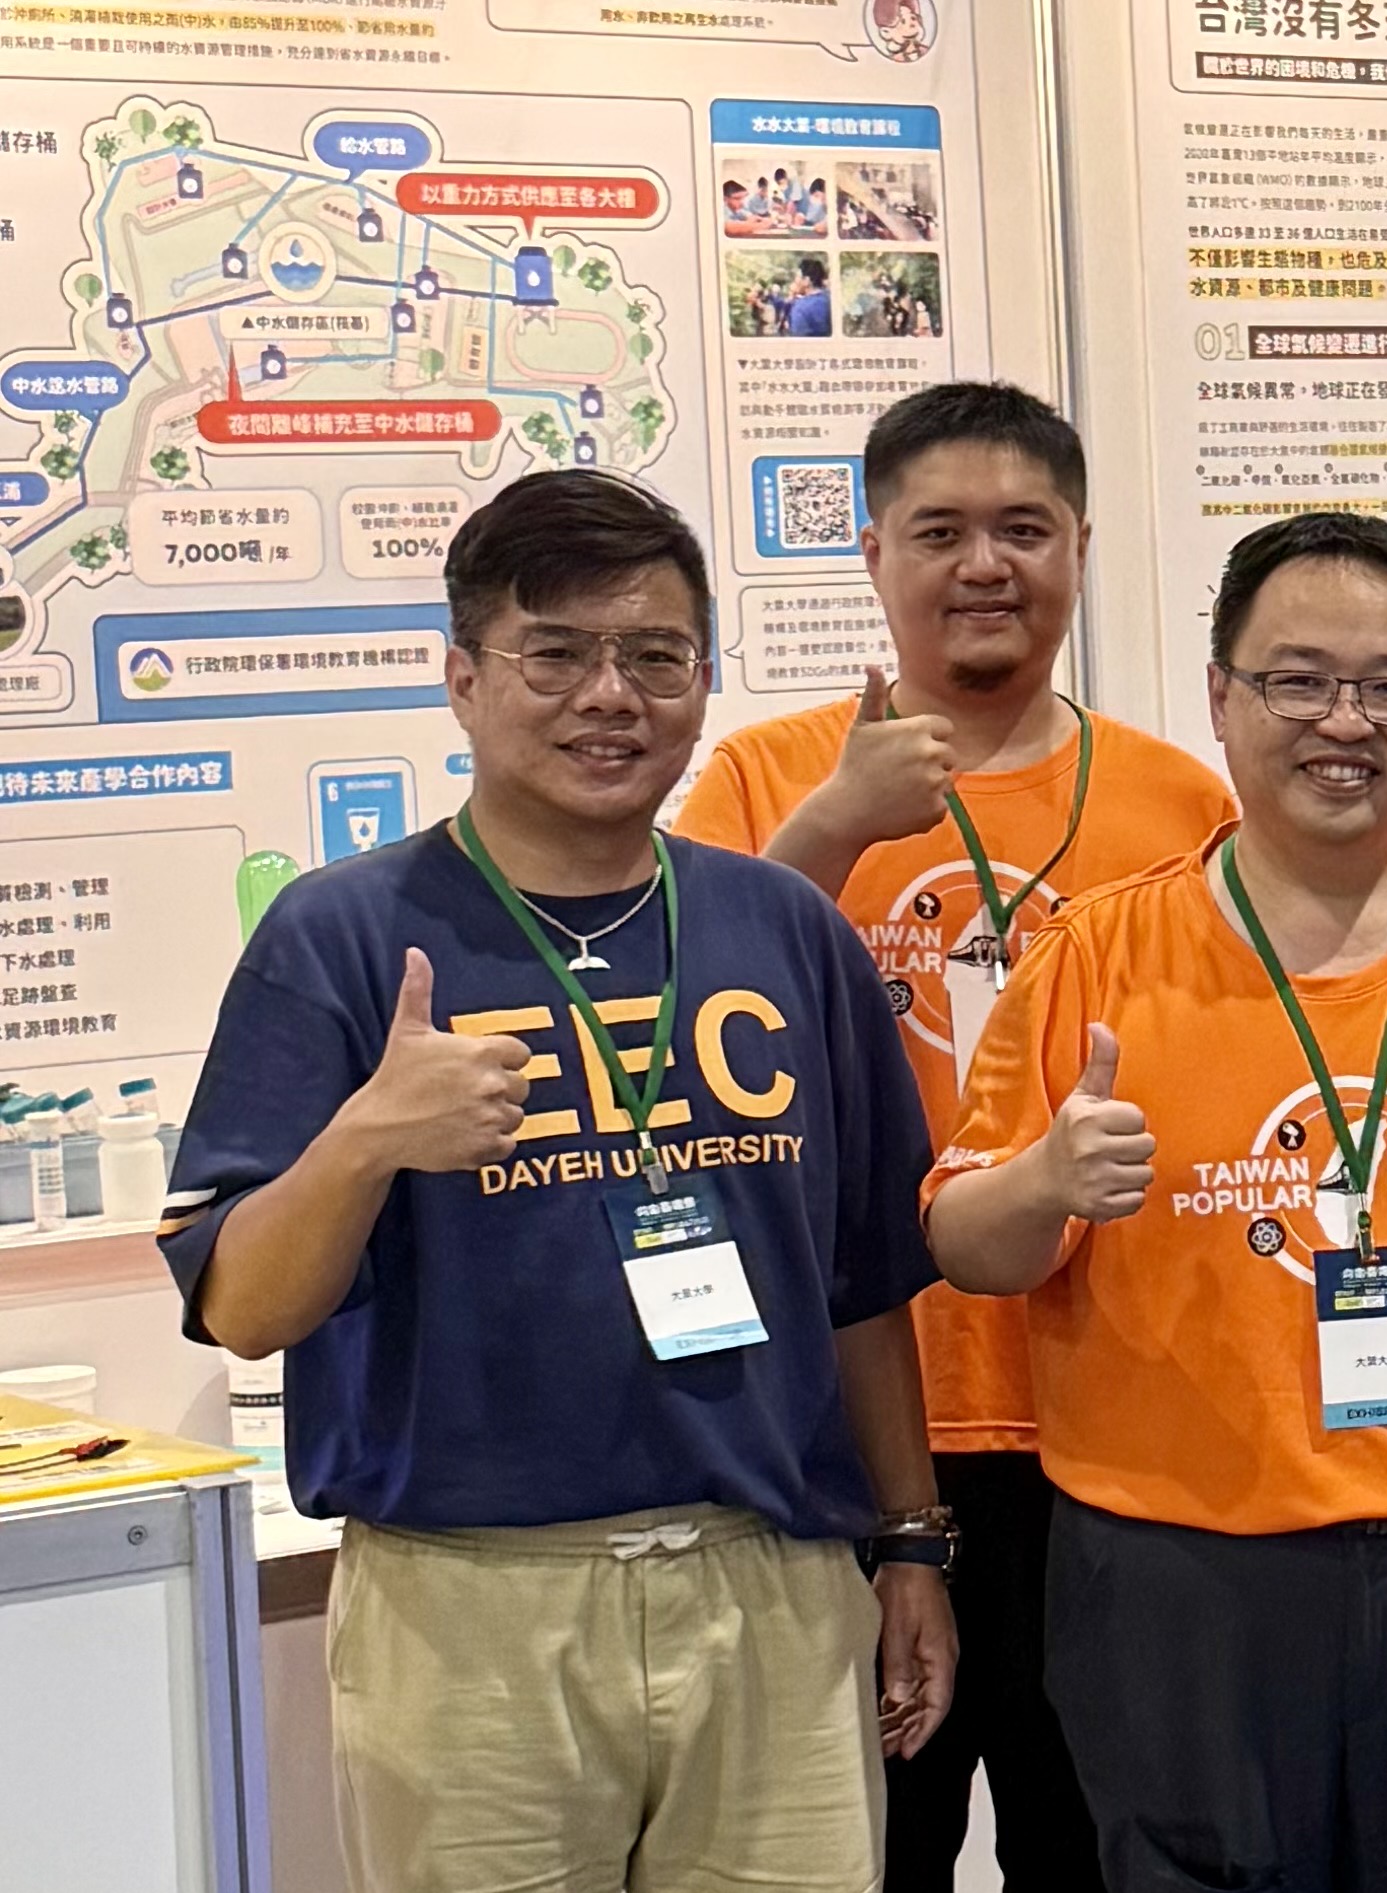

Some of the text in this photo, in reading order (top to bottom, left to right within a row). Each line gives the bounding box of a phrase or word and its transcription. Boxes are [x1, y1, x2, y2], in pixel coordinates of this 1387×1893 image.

[1196, 321, 1246, 360] 01
[372, 537, 444, 558] 100%
[328, 782, 339, 802] 6
[858, 925, 943, 949] AIWAN
[872, 951, 943, 975] ULAR
[0, 1013, 118, 1041] 資源環境教育
[481, 1148, 604, 1196] DAYEH
[1193, 1157, 1310, 1189] TAIWAN
[1172, 1184, 1313, 1217] POPULAR
